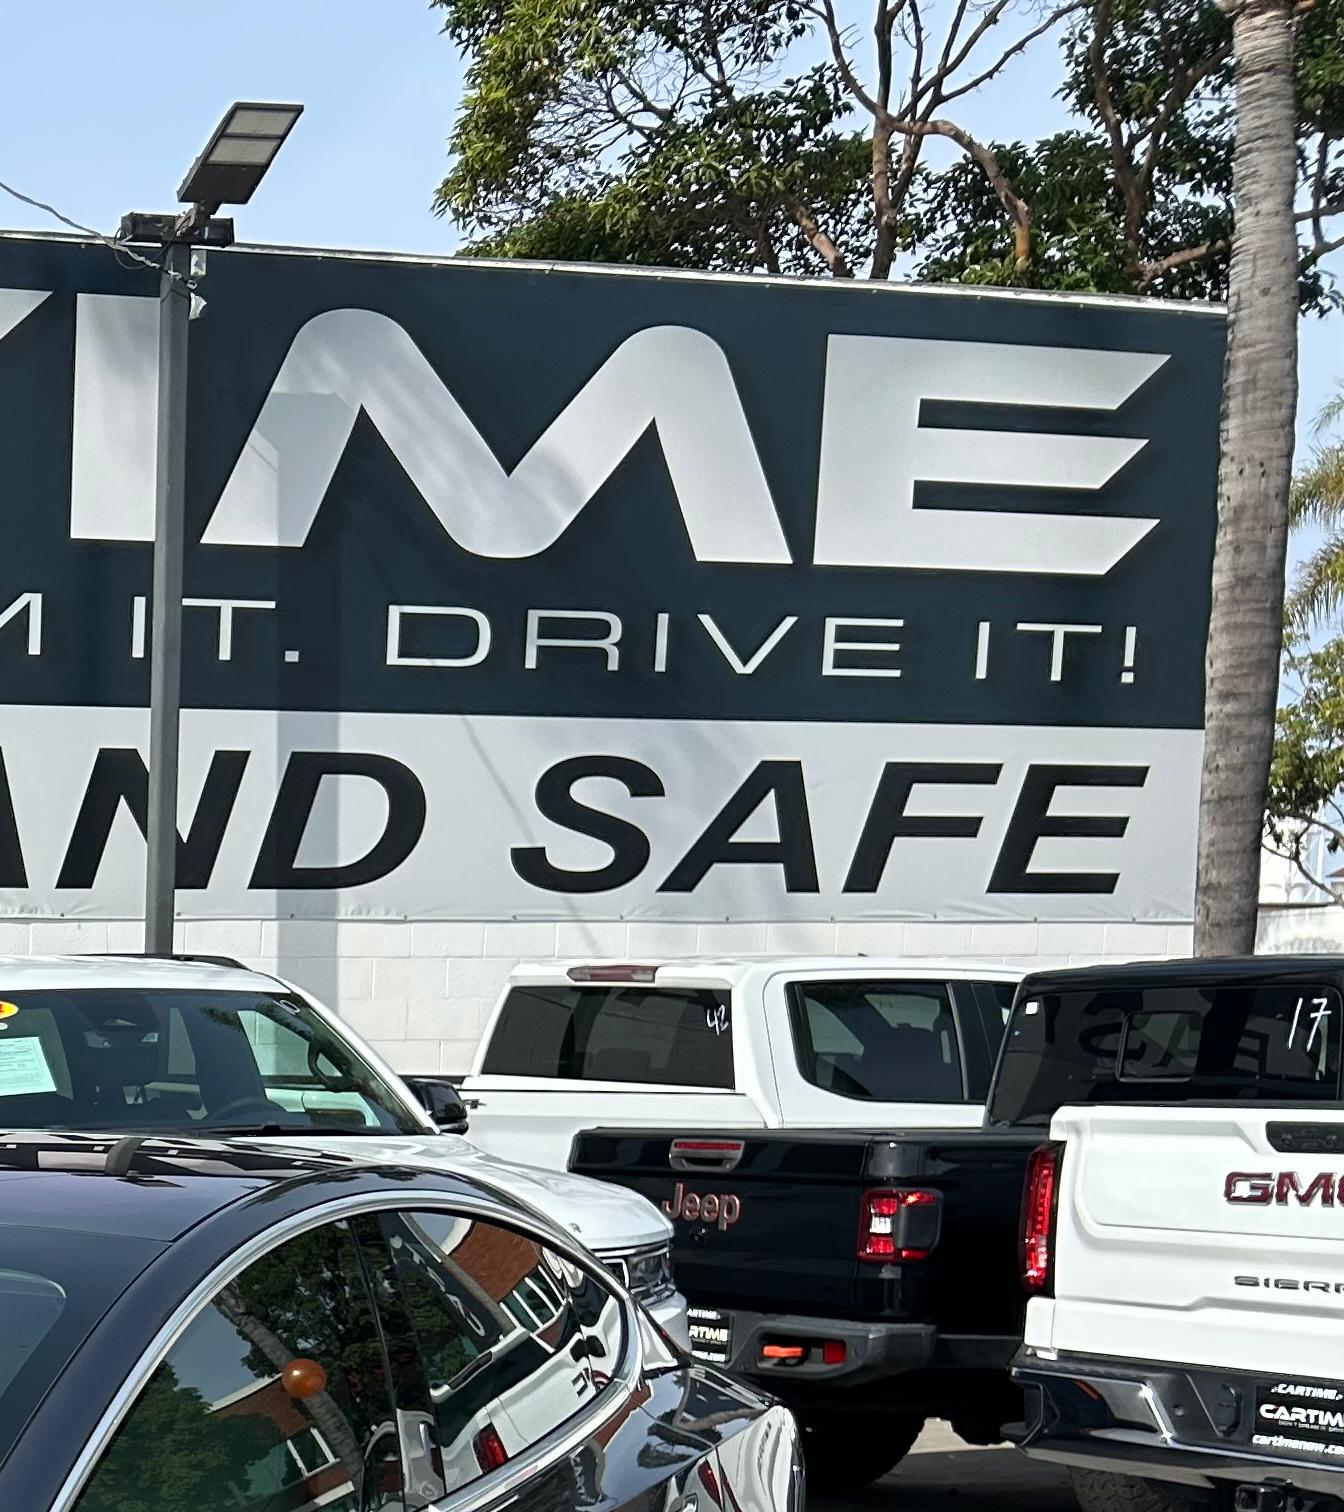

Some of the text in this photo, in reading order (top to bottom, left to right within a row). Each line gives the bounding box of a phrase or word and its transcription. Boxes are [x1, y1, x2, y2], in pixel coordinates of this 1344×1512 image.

[131, 596, 300, 663] IT.
[386, 603, 905, 678] DRIVE
[974, 621, 1138, 684] IT!
[510, 754, 1151, 895] SAFE
[707, 1004, 729, 1036] 42
[1288, 997, 1332, 1052] 17
[662, 1182, 741, 1232] Jeep
[1224, 1171, 1344, 1207] GM
[689, 1325, 728, 1342] RTIME
[1277, 1384, 1337, 1400] CARTIME
[1259, 1404, 1344, 1428] CARTIM
